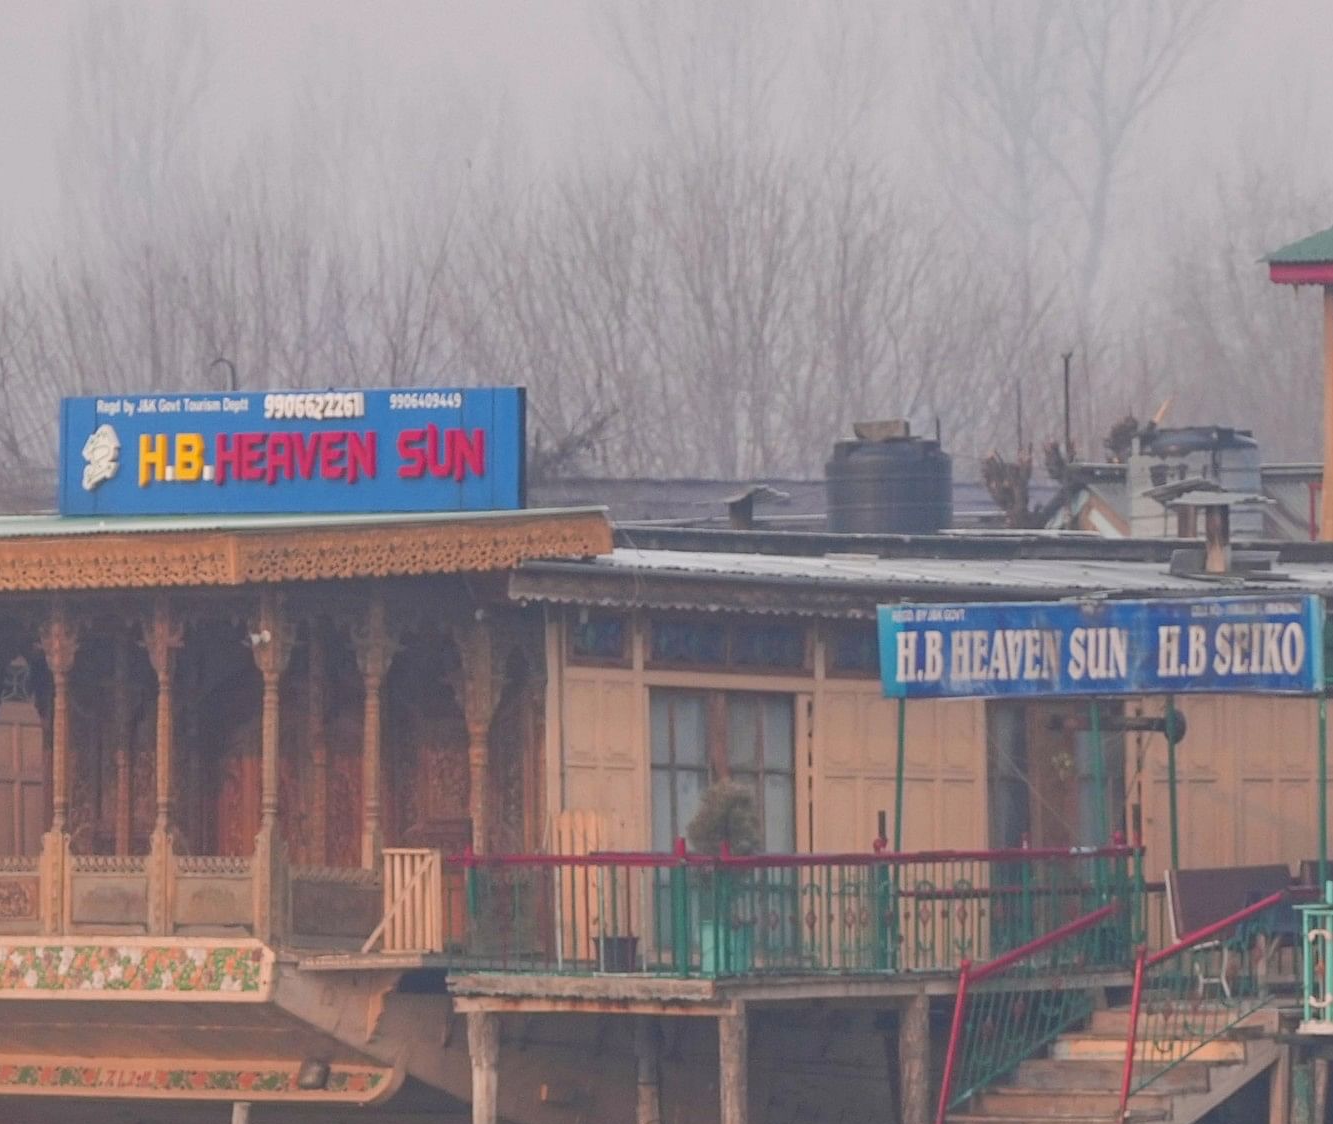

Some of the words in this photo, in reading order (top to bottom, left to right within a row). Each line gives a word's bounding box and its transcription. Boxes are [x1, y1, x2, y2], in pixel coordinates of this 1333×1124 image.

[184, 397, 221, 412] Tourism
[397, 422, 487, 485] SUN
[896, 629, 944, 683] H.B
[950, 628, 1062, 682] HEAVEN
[1067, 626, 1130, 680] SUN
[1157, 624, 1207, 677] H.B
[1213, 621, 1306, 676] SEIKO
